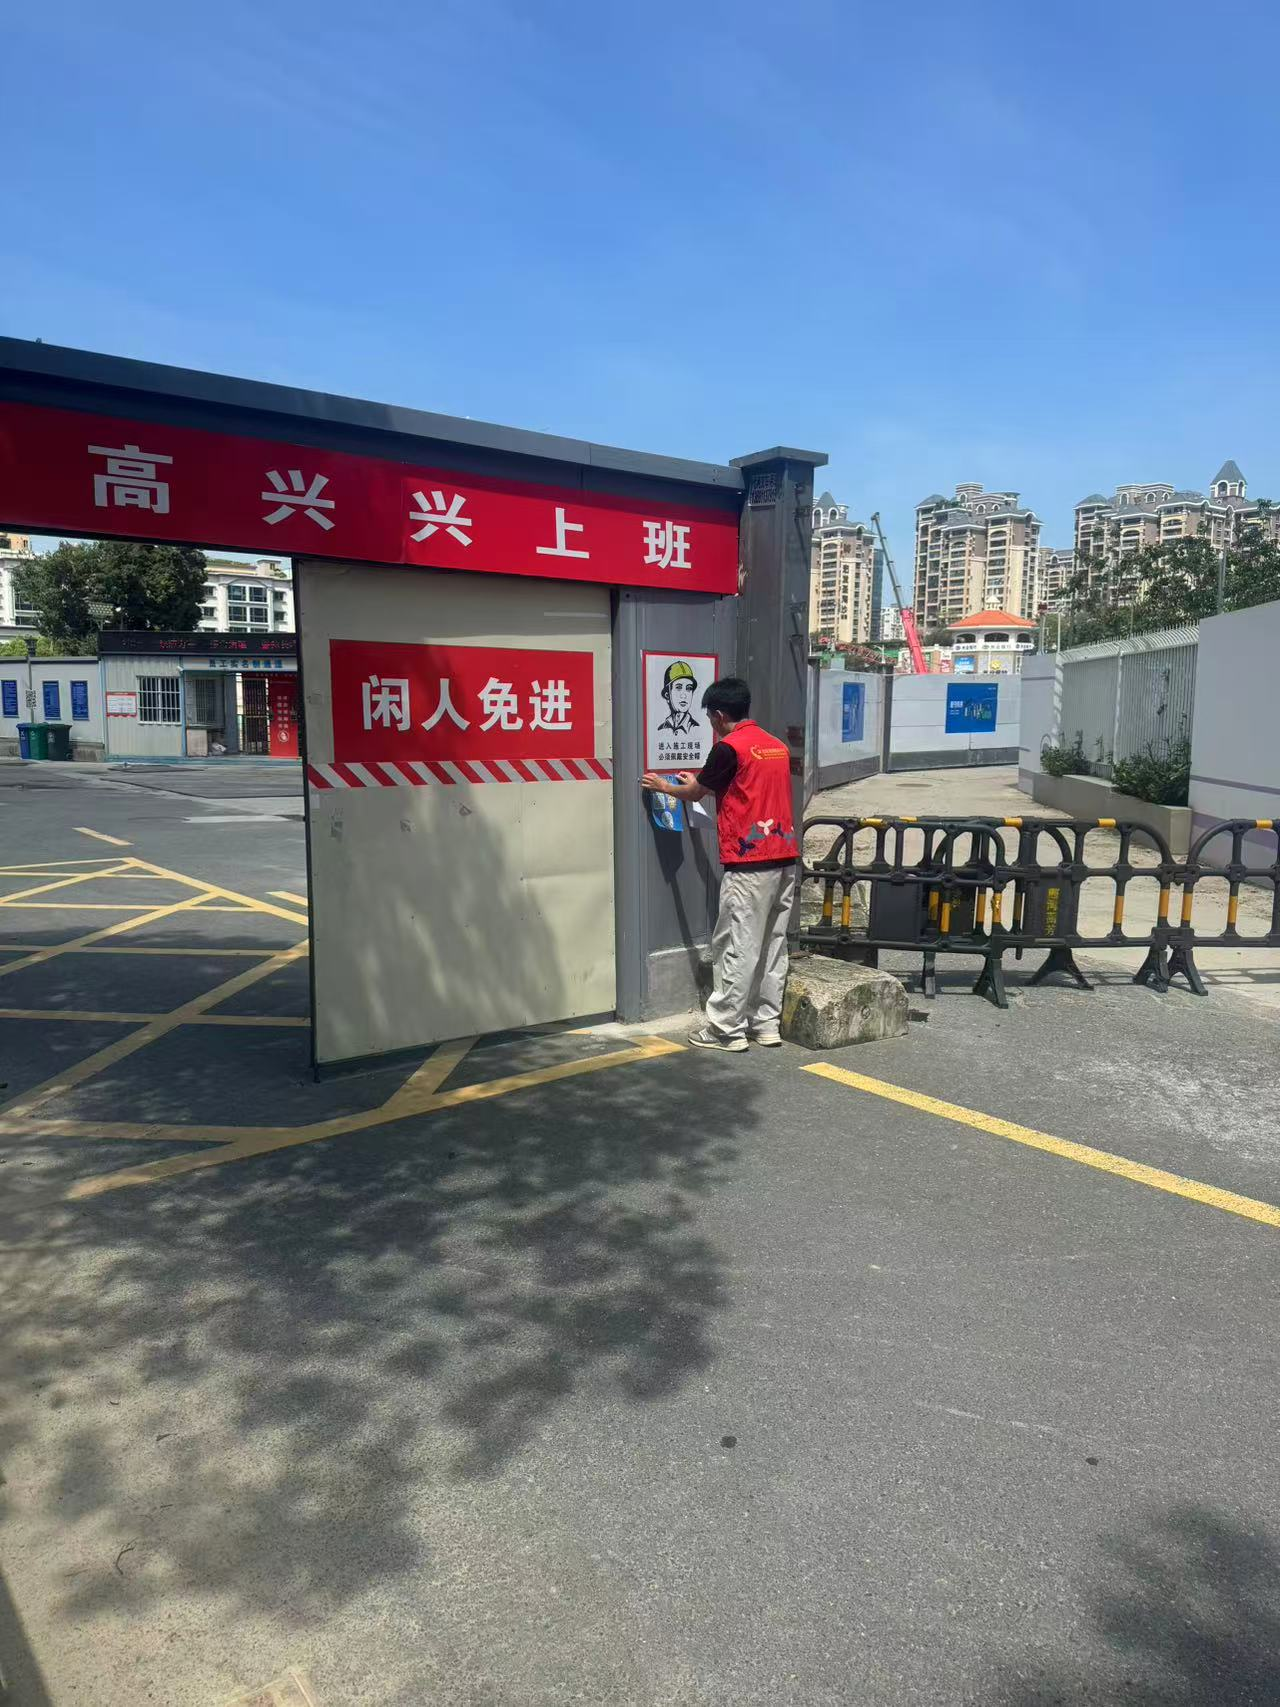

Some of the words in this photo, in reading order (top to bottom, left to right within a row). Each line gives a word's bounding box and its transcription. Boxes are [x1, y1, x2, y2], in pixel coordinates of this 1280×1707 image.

[87, 443, 692, 571] 高兴兴上班
[361, 674, 573, 732] 闲人免进
[658, 741, 701, 750] 进入施工现场
[658, 752, 701, 761] 必须佩戴安全帽
